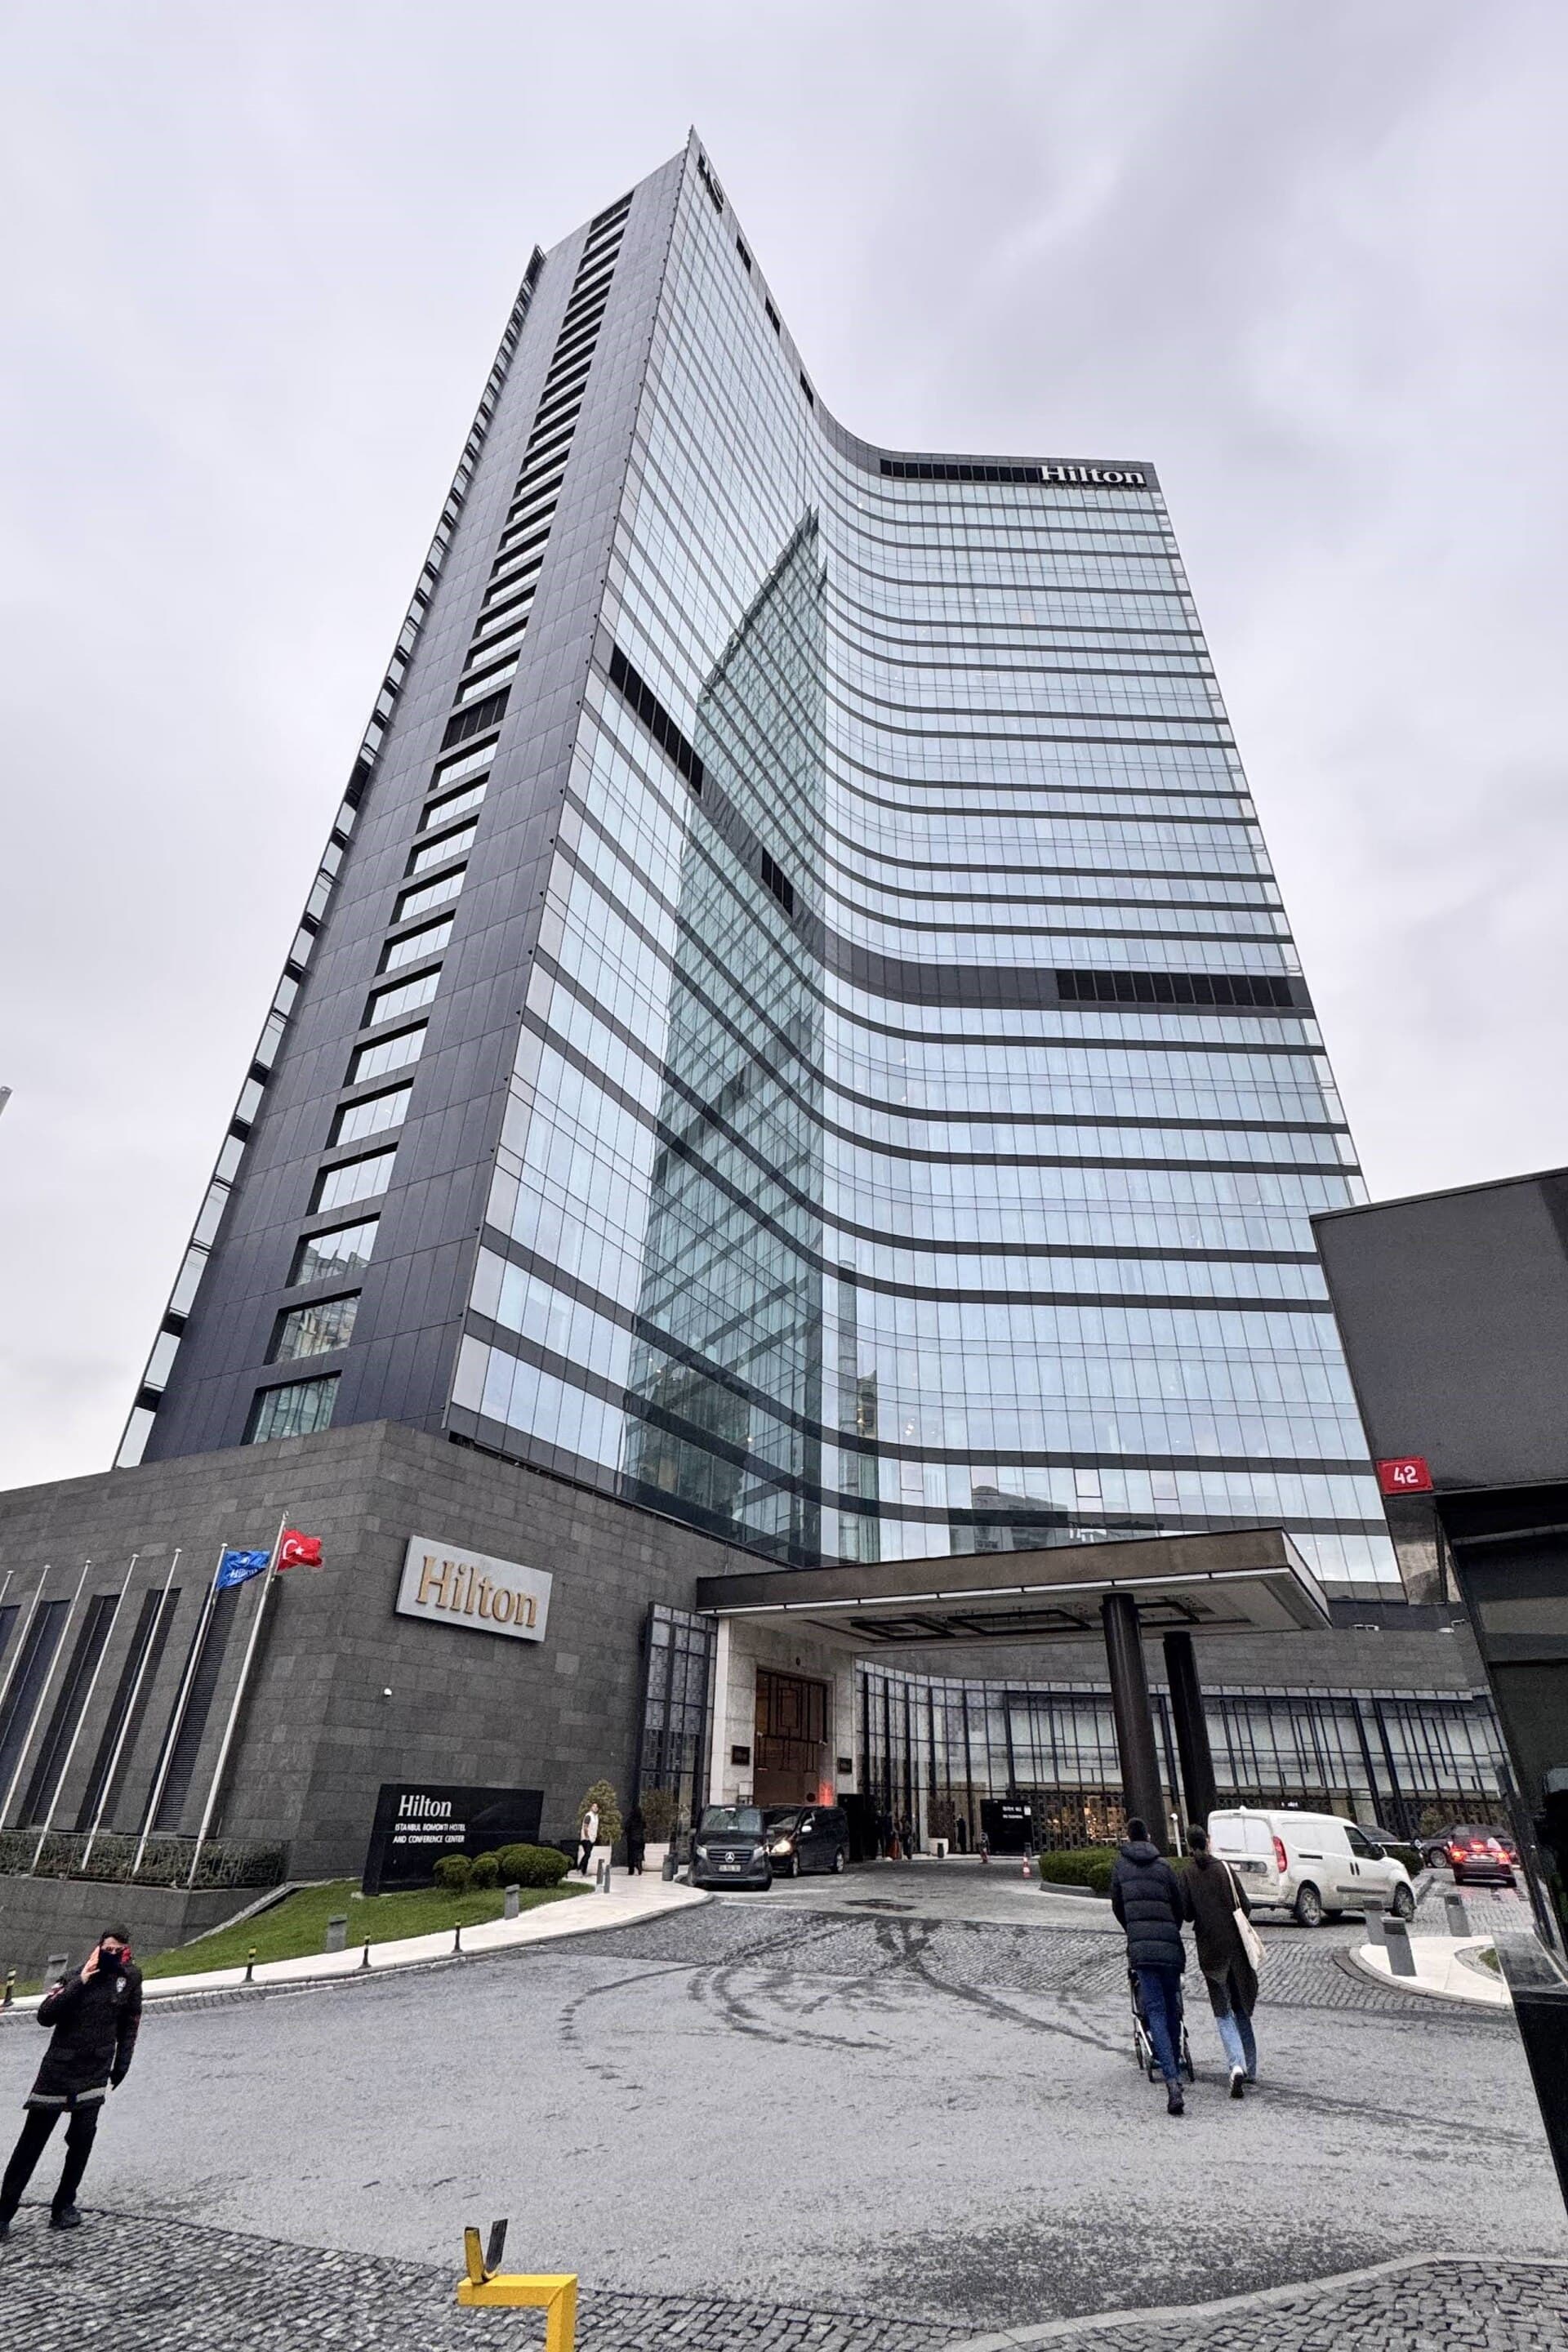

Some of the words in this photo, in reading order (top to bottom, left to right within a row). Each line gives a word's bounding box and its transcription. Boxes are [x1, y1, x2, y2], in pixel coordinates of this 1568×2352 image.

[1040, 466, 1146, 484] Hilton
[1393, 1465, 1419, 1484] 42
[416, 1555, 537, 1628] Hilton
[398, 1795, 452, 1817] Hilton
[448, 1823, 466, 1832] HOTEL
[392, 1835, 407, 1844] AND
[408, 1835, 443, 1843] CONFERENCE
[444, 1835, 465, 1843] CENTER
